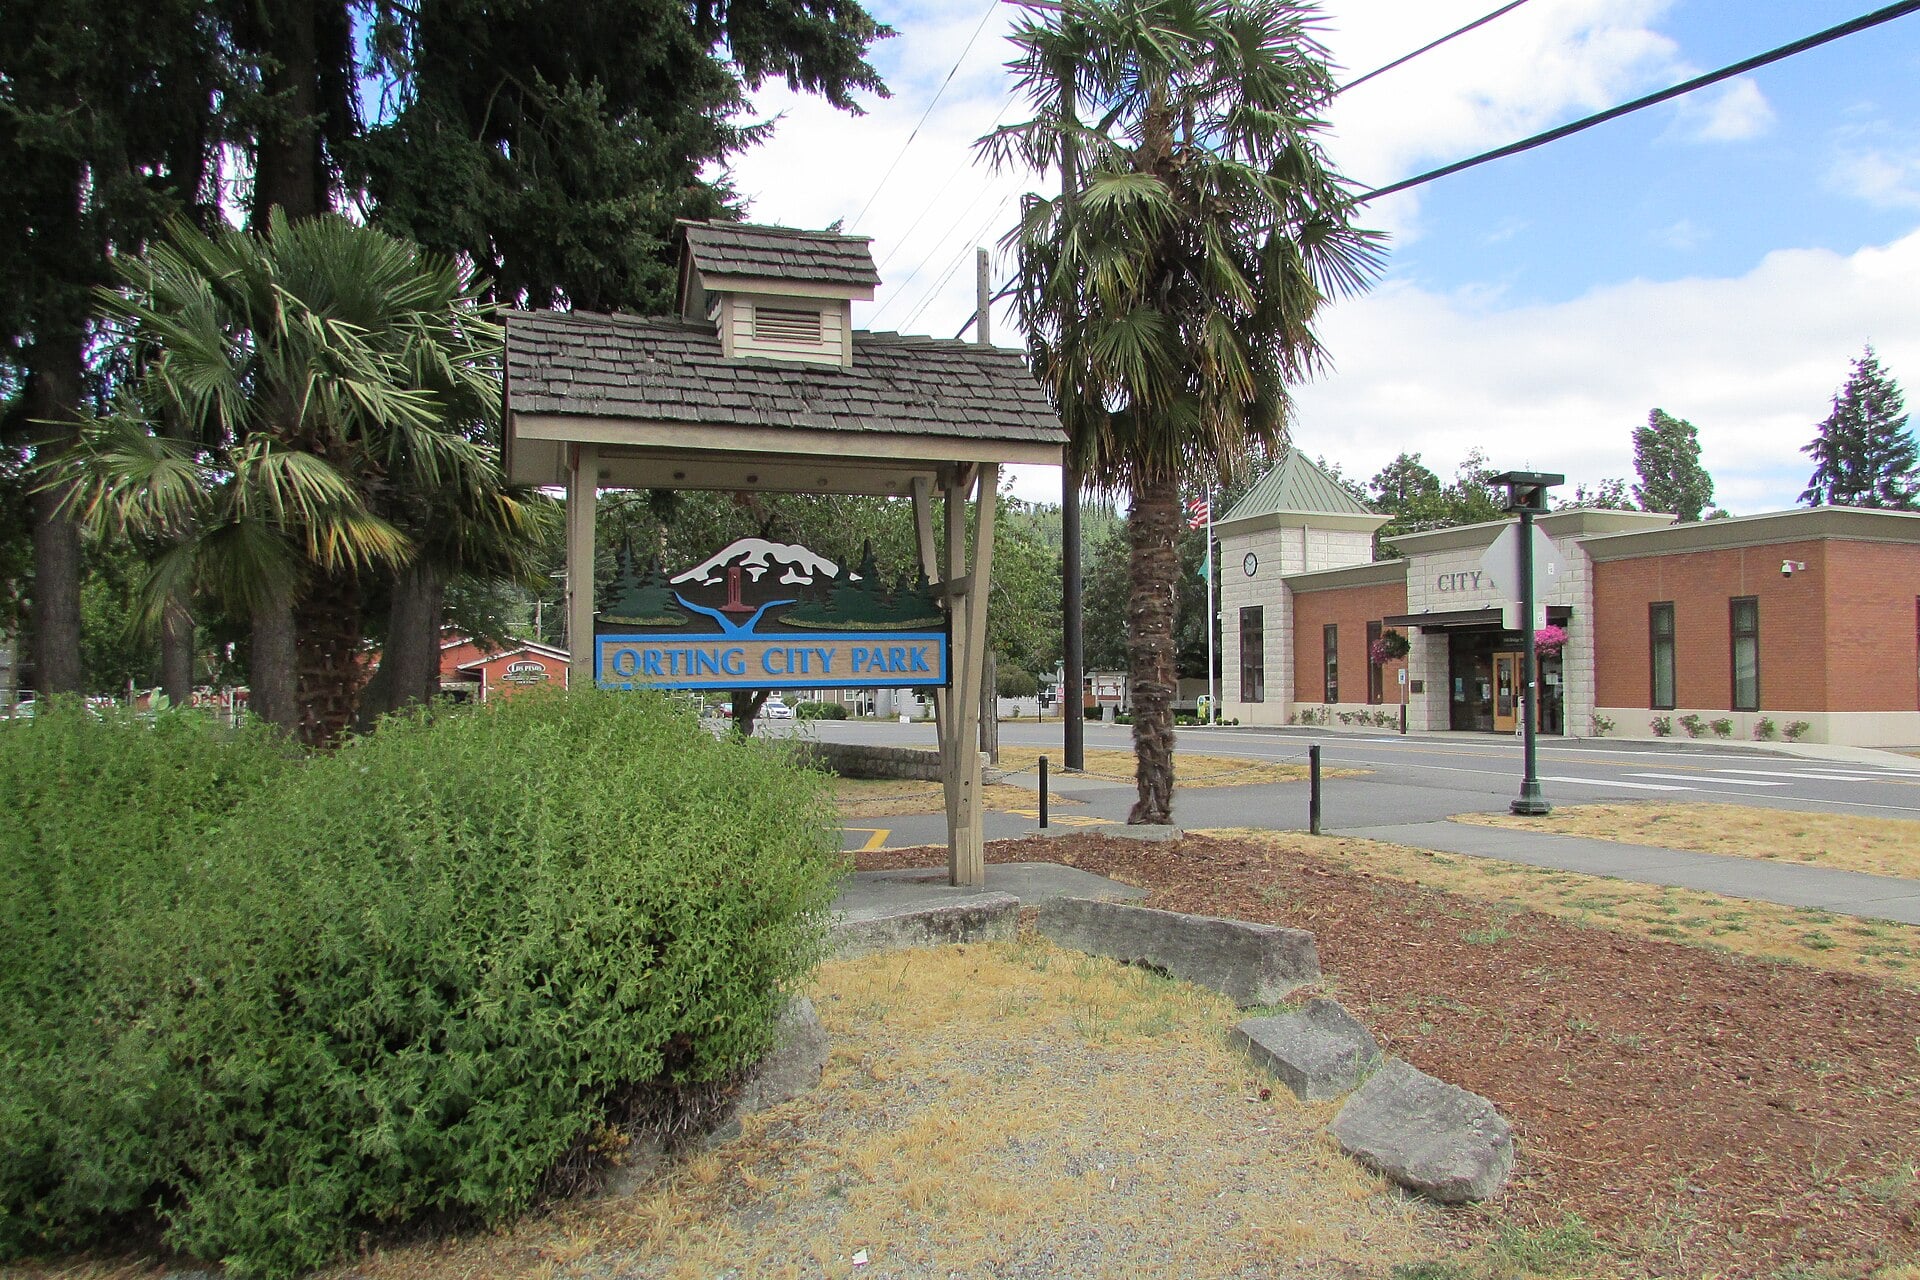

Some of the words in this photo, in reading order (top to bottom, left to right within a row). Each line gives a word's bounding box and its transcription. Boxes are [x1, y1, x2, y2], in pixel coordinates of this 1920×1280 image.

[1438, 571, 1482, 592] CITY
[612, 647, 746, 676] ORTING
[761, 646, 836, 674] CITY
[852, 646, 931, 672] PARK
